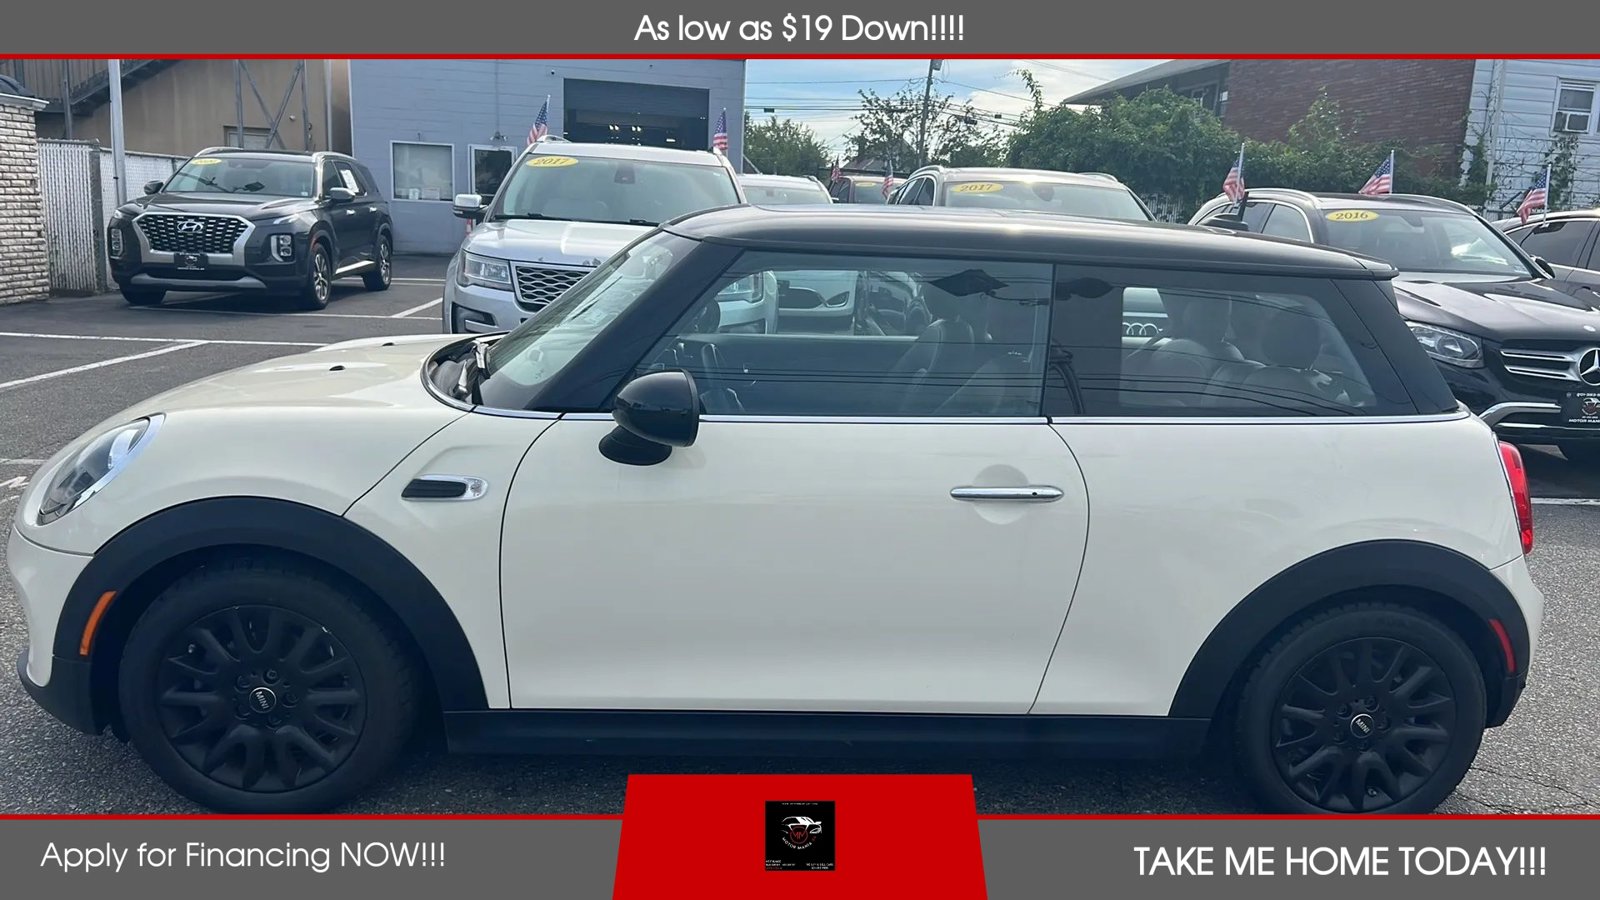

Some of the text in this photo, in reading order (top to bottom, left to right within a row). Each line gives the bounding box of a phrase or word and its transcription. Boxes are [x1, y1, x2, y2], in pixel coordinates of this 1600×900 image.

[533, 157, 569, 165] 2017
[960, 183, 993, 192] 2017
[1335, 211, 1369, 220] 2016
[255, 690, 270, 709] MINI
[1355, 718, 1370, 734] MINI
